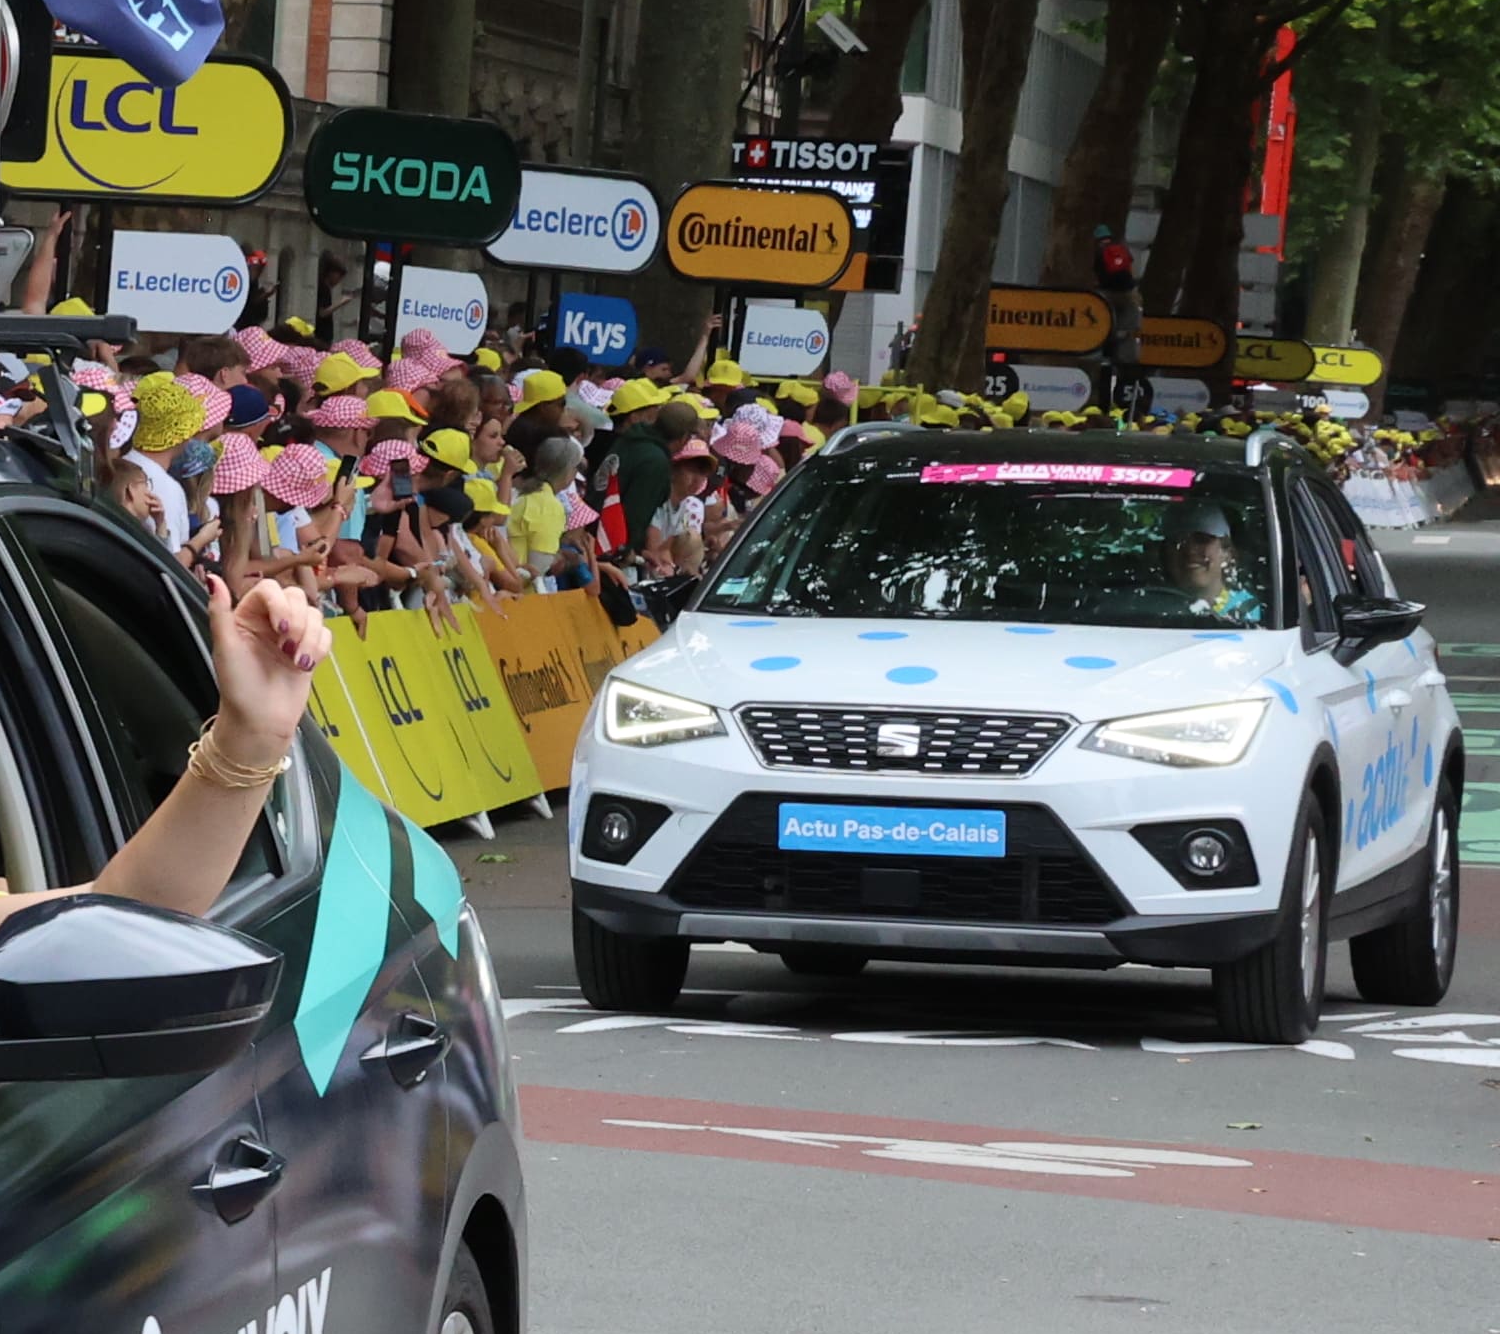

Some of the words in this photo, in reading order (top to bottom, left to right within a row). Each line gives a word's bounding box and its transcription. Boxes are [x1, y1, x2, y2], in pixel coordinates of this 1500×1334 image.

[70, 79, 199, 136] LCL
[771, 141, 878, 171] TISSOT
[512, 207, 609, 238] Leclerc
[678, 212, 818, 254] Continental
[117, 270, 211, 295] E.Leclerc
[402, 298, 463, 323] E.Leclerc
[990, 304, 1077, 328] inental
[563, 310, 627, 356] Krys
[746, 330, 804, 349] E.Leclerc
[1237, 344, 1282, 361] CL
[1316, 351, 1352, 367] CL
[985, 375, 1008, 396] 25
[1110, 468, 1173, 484] 3507
[368, 656, 424, 726] LCL
[443, 647, 490, 712] LCL
[784, 816, 837, 838] Actu
[843, 819, 999, 843] Pas-de-Calais
